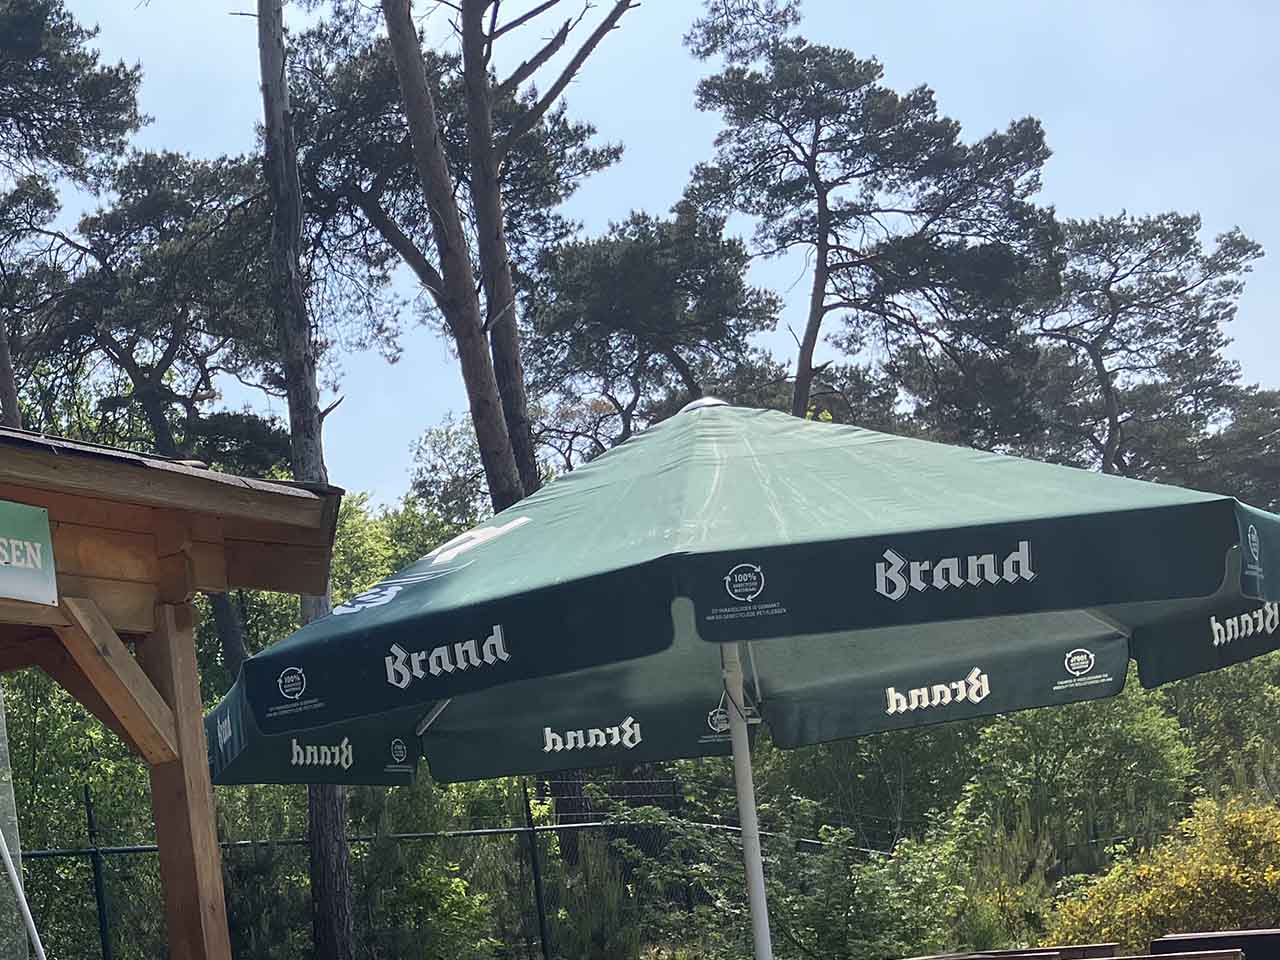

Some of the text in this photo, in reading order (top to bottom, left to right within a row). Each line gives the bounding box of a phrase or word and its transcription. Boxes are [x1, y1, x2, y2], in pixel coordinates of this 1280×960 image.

[734, 573, 757, 582] 100%
[874, 540, 1039, 601] Brand
[384, 623, 512, 690] Brand
